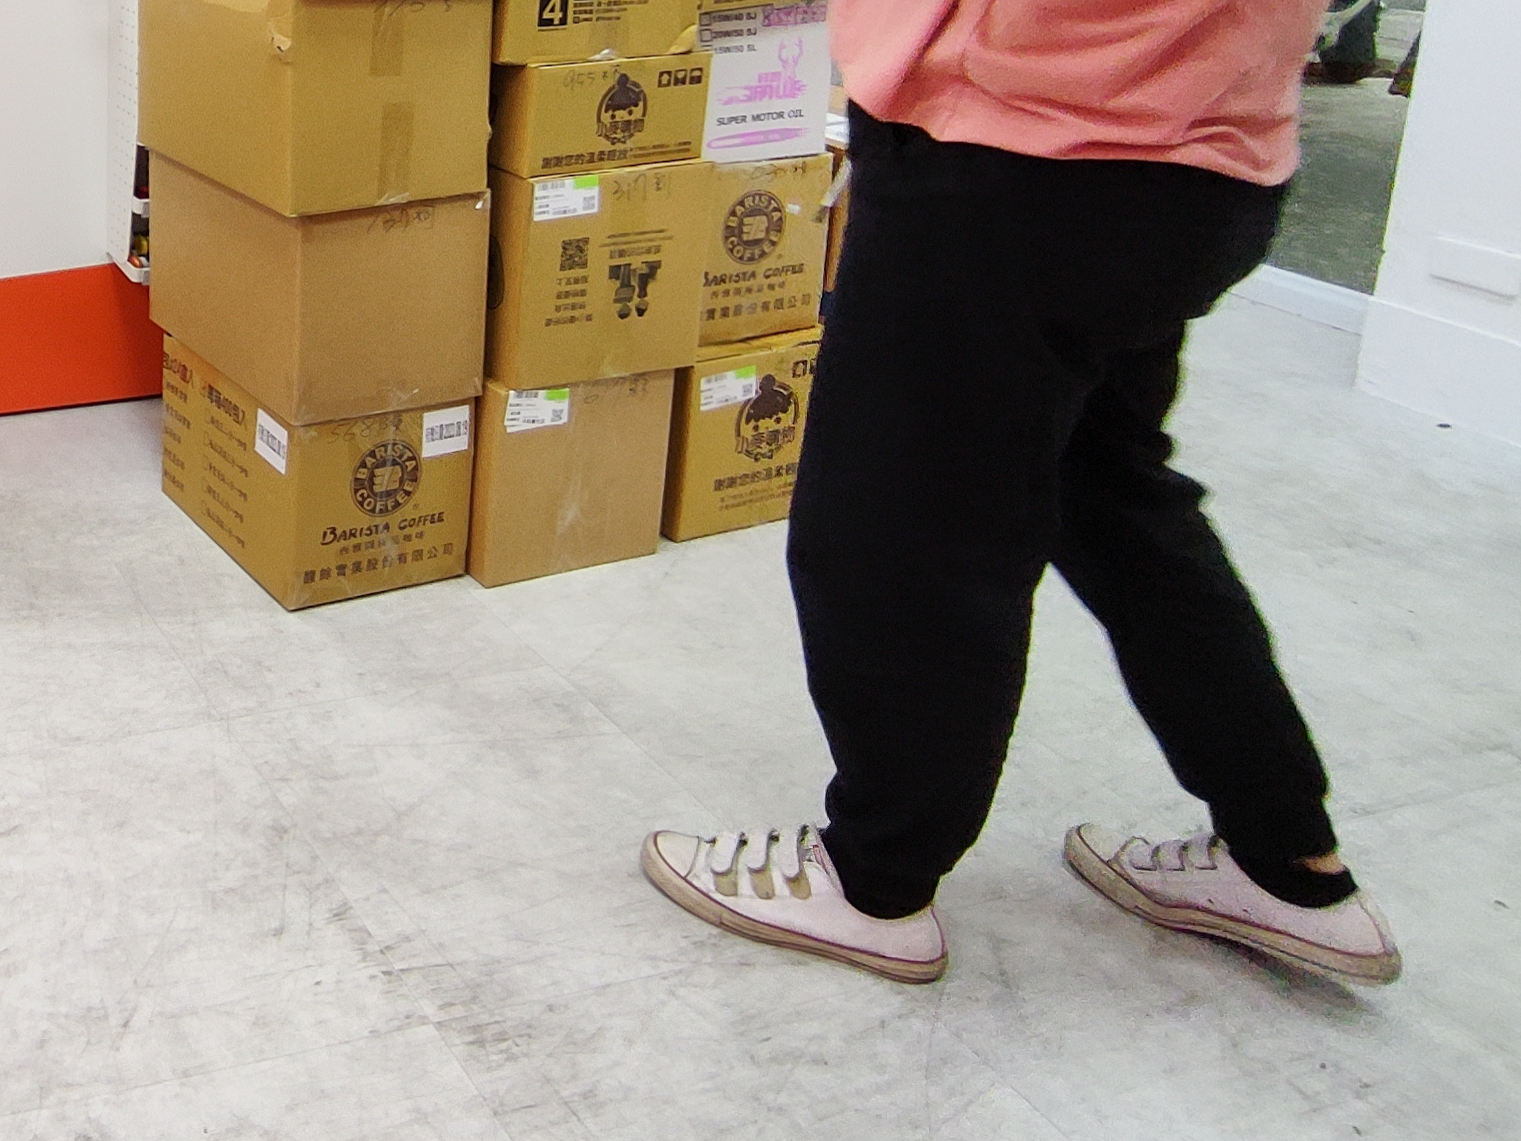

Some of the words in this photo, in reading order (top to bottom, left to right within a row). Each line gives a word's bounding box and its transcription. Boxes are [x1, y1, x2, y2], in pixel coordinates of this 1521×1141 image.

[716, 115, 748, 127] SUPER
[751, 111, 785, 123] MOTOR
[787, 109, 804, 119] OIL
[320, 521, 391, 546] BARISTA
[397, 511, 445, 531] COFFEE
